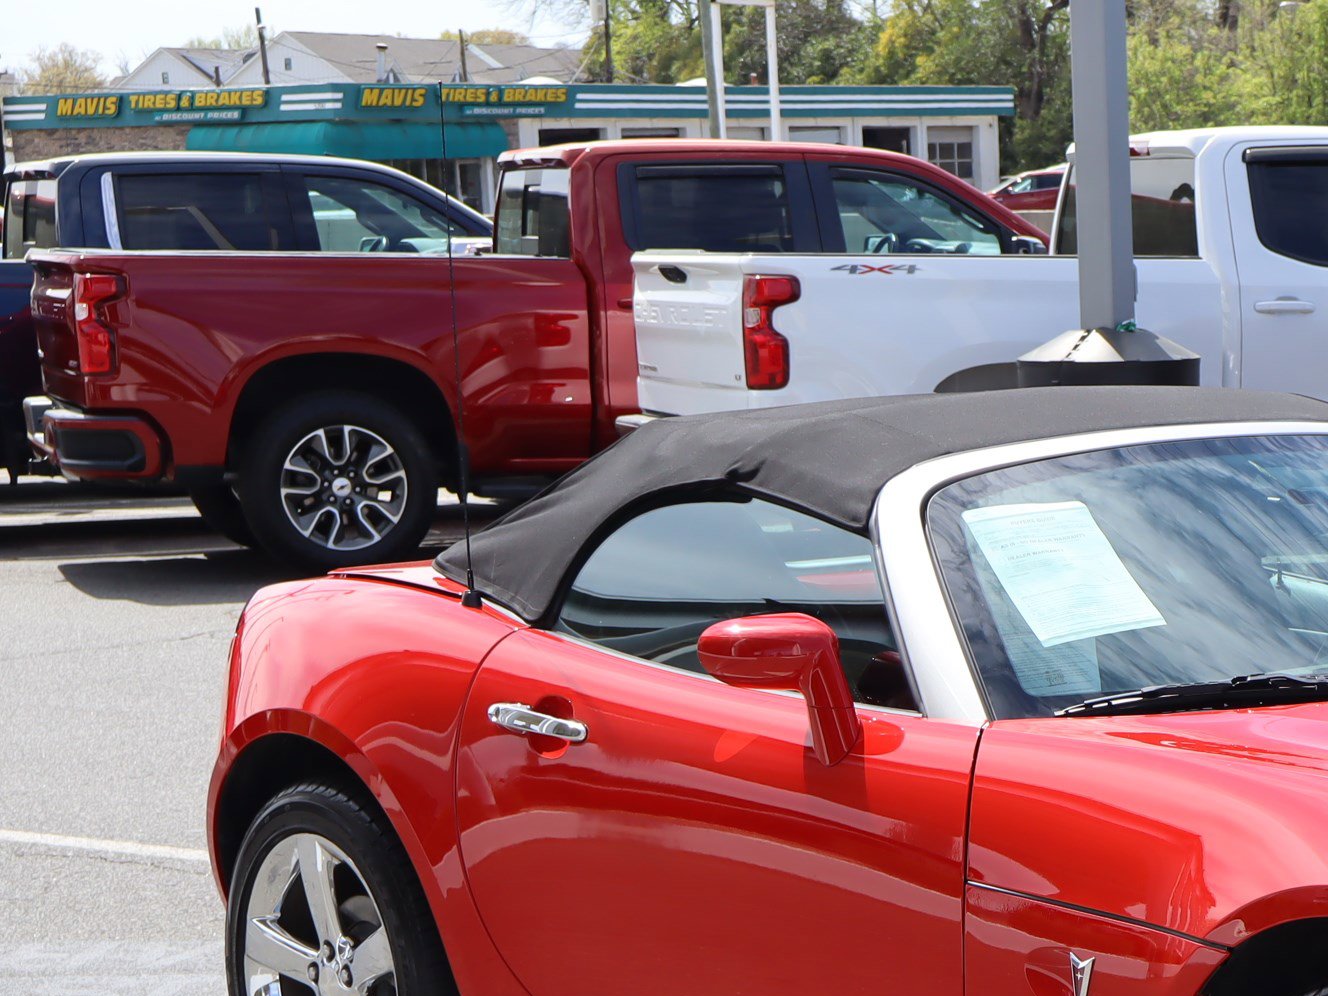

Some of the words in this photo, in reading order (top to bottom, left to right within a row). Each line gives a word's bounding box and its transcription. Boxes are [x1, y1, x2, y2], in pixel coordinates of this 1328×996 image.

[57, 96, 119, 117] MAVIS
[129, 93, 178, 110] TIRES
[179, 94, 191, 108] &
[194, 89, 265, 107] BRAKES
[361, 88, 428, 107] MAVIS
[440, 88, 487, 102] TIRES
[489, 90, 499, 102] &
[503, 88, 568, 102] BRAKES
[207, 111, 239, 119] PRICES
